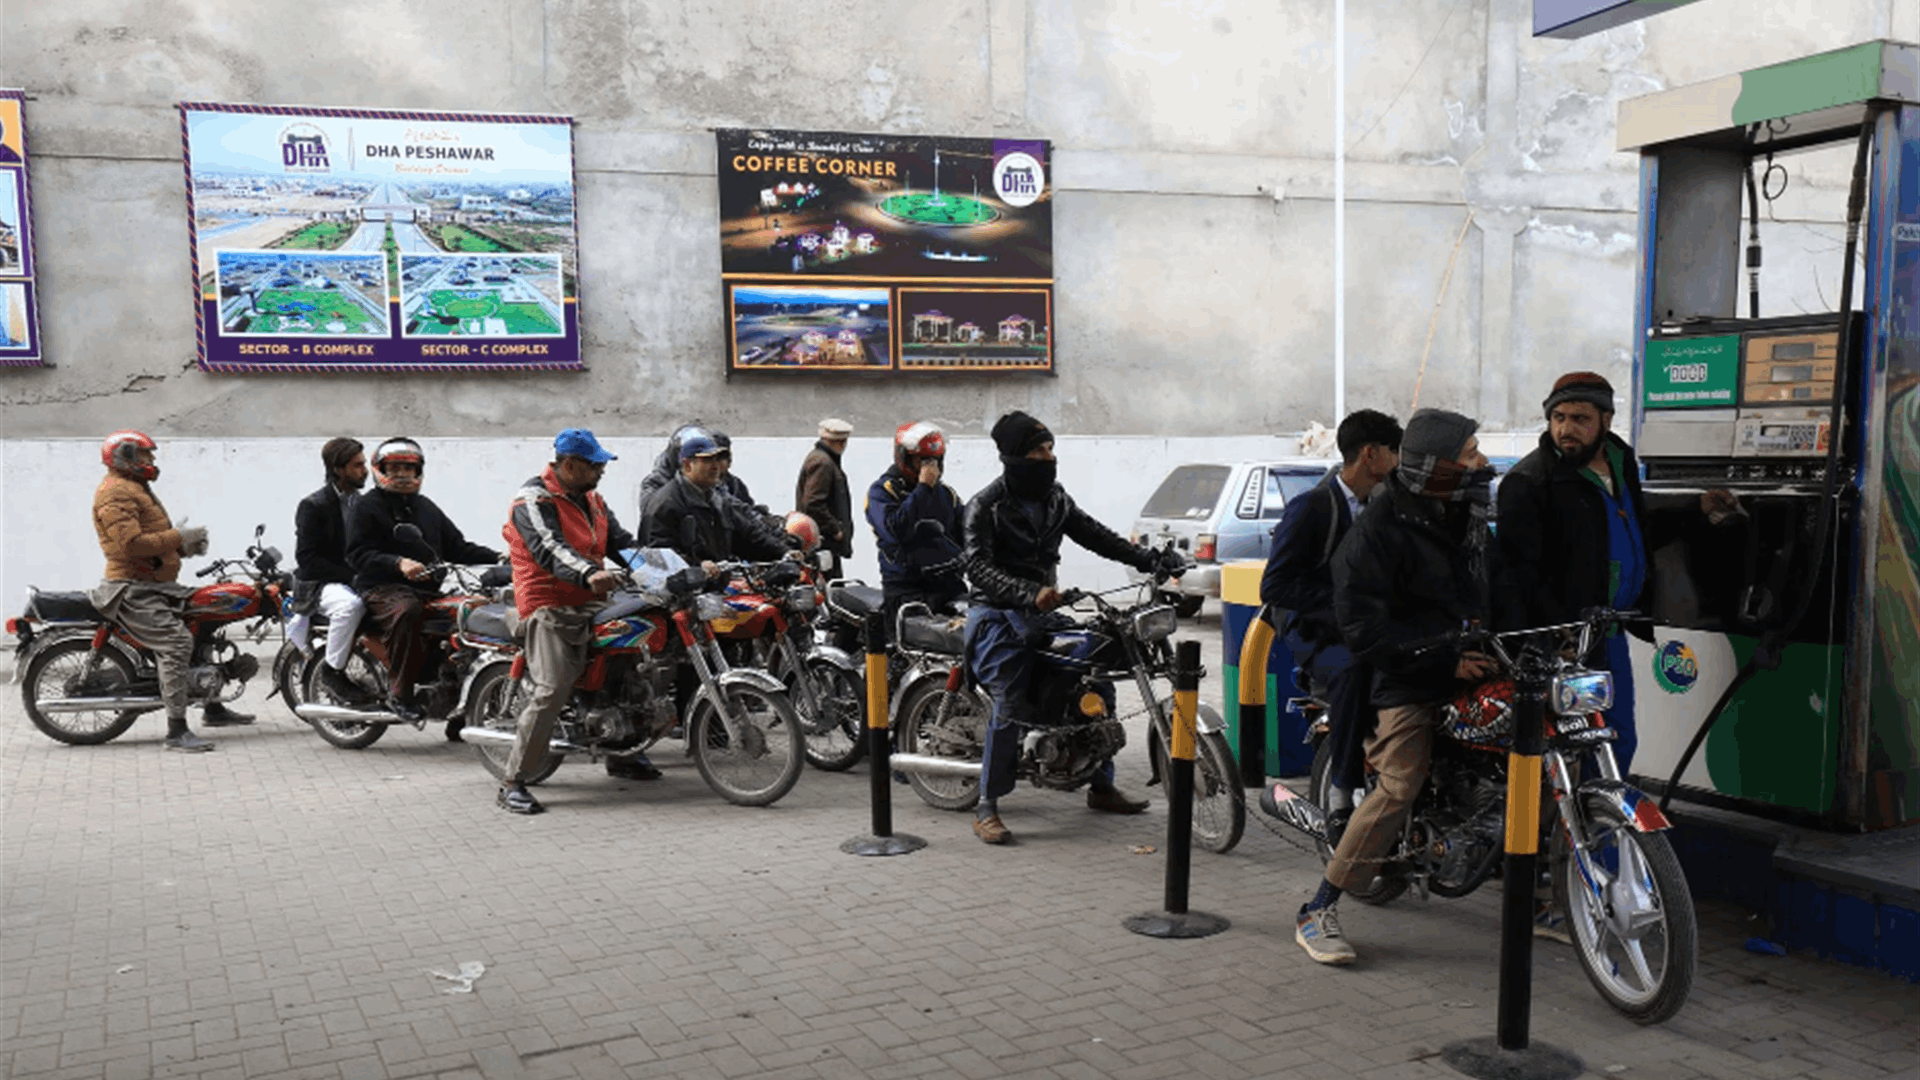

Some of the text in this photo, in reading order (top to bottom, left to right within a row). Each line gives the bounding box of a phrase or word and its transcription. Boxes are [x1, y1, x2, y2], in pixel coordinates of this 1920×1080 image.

[282, 143, 330, 167] DHA
[366, 144, 495, 161] DHA PESHAWAR
[732, 155, 897, 177] COFFEE CORNER
[1002, 173, 1036, 193] DHA
[239, 344, 290, 355] SECTOR
[302, 344, 311, 355] B
[313, 344, 375, 355] COMPLEX
[421, 344, 470, 355] SECTOR
[480, 344, 489, 355] C
[491, 344, 549, 355] COMPLEX
[1664, 654, 1695, 676] PSO
